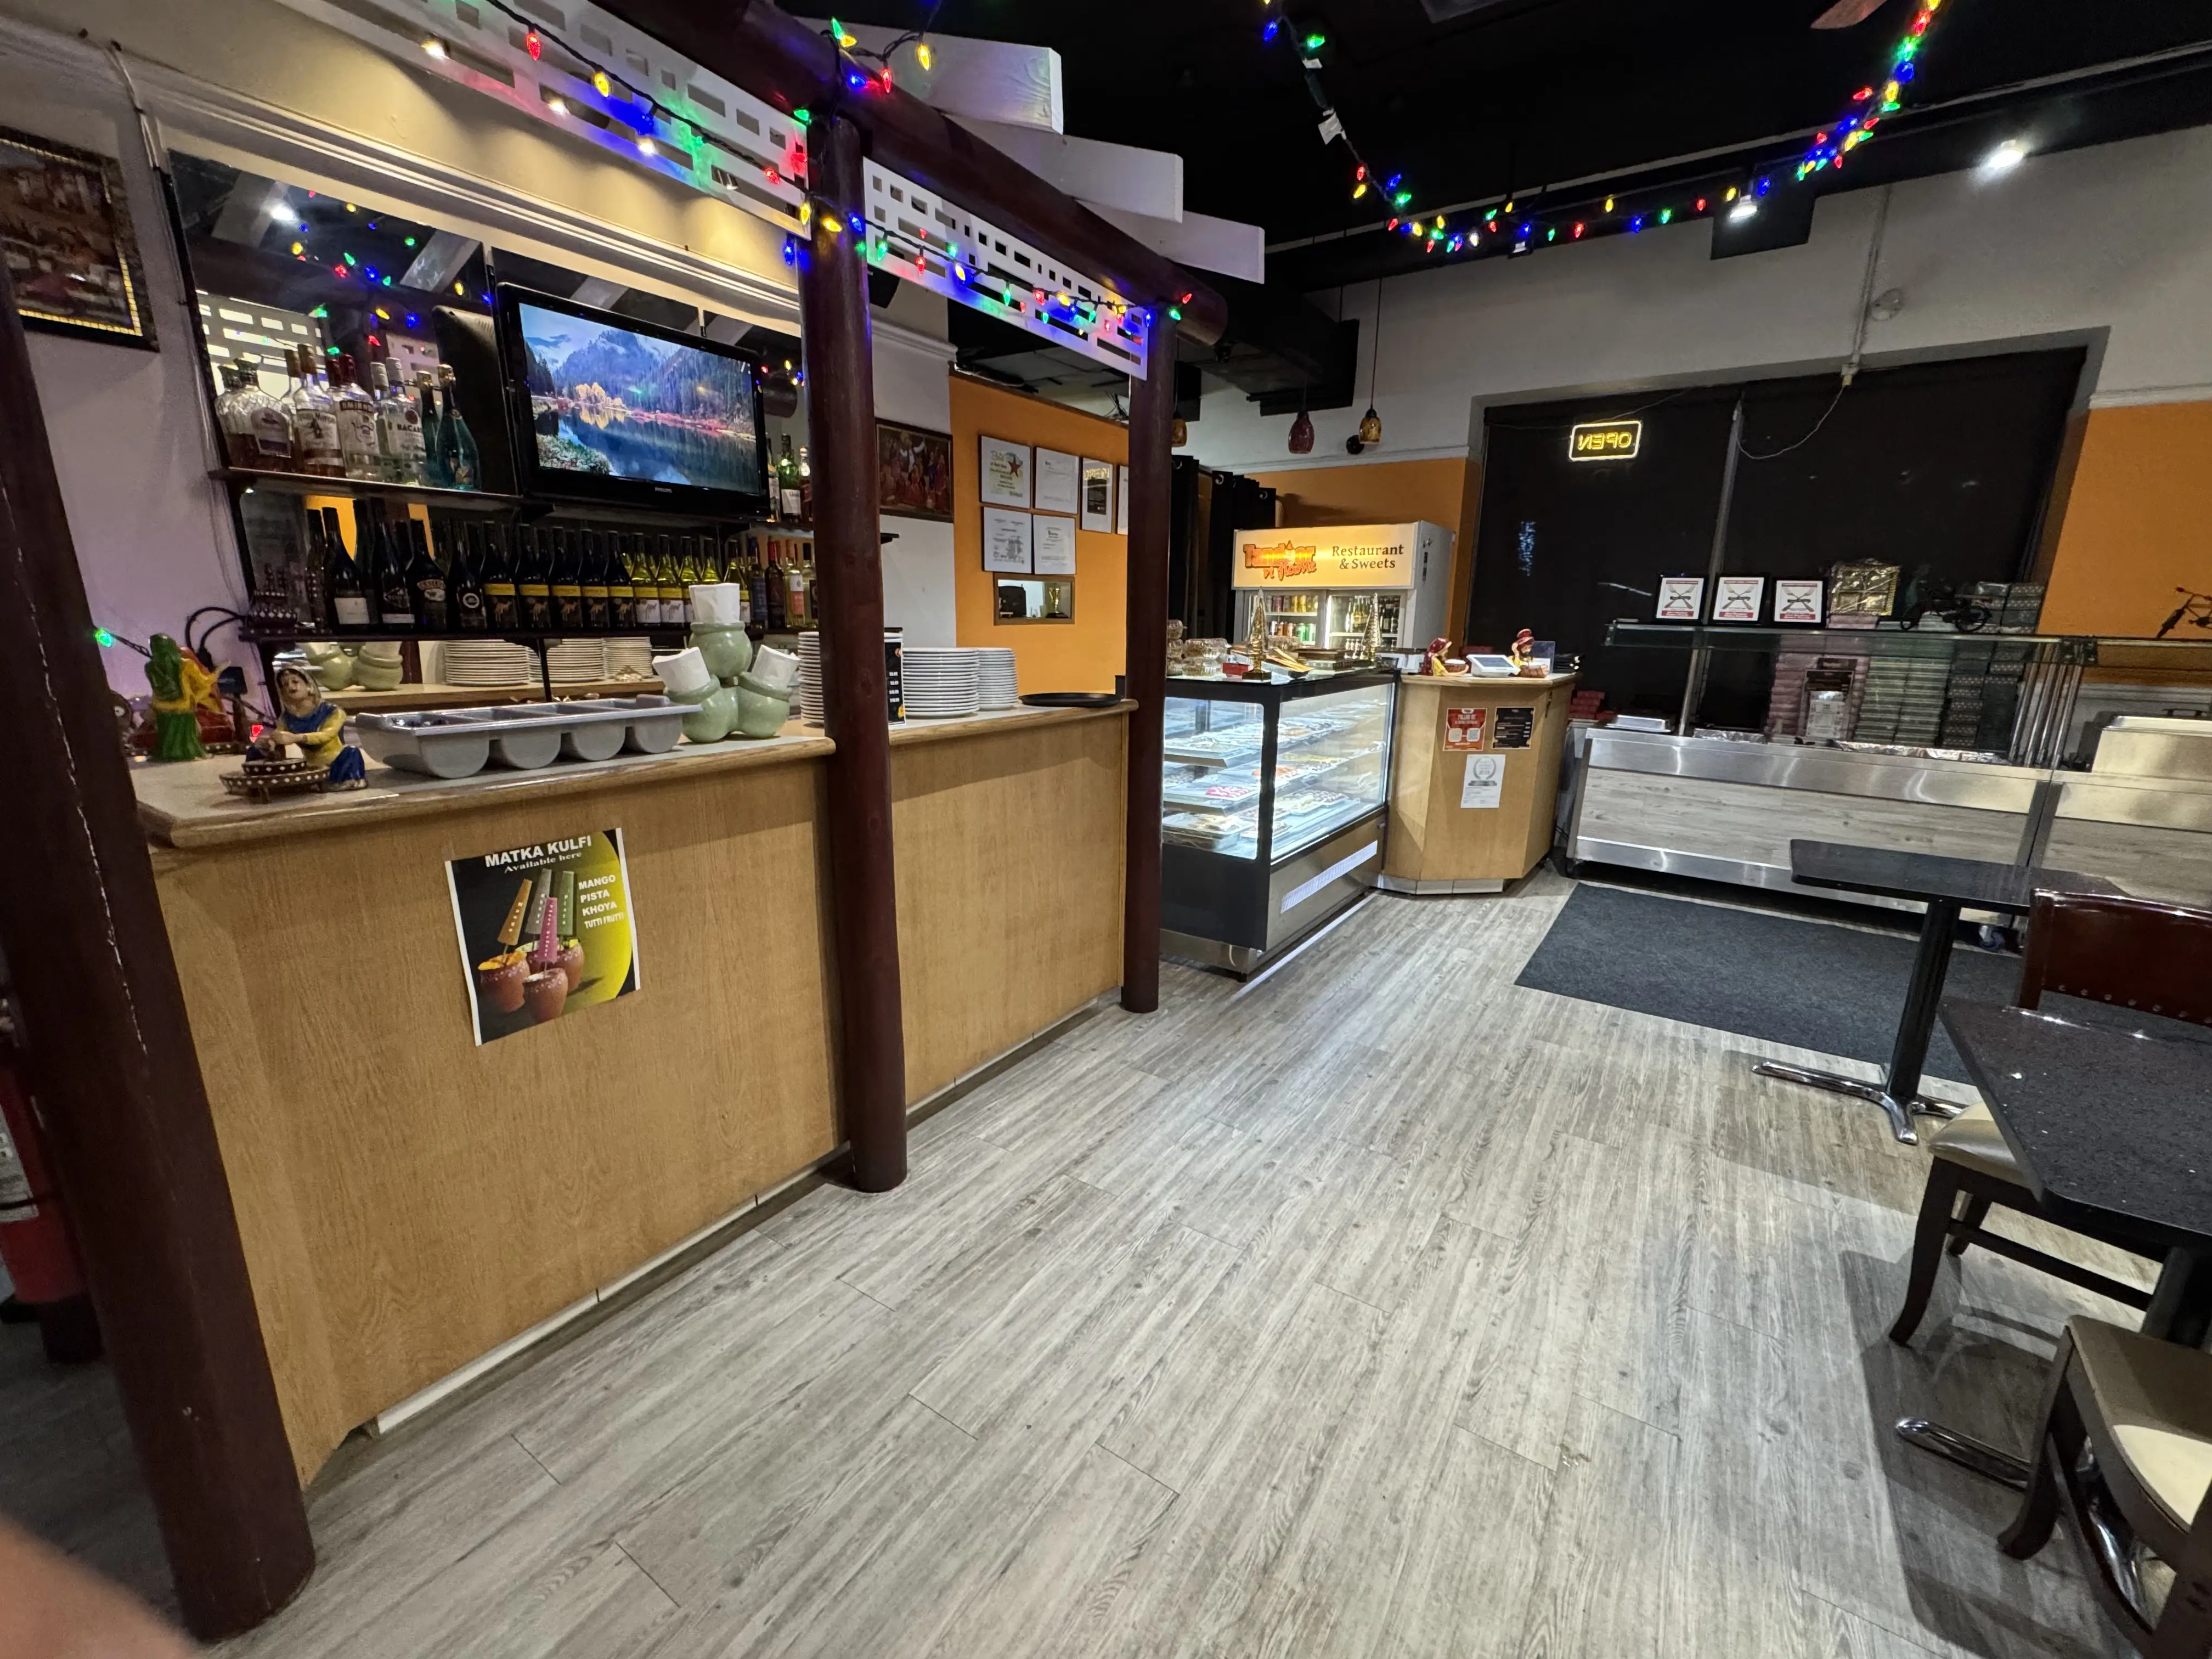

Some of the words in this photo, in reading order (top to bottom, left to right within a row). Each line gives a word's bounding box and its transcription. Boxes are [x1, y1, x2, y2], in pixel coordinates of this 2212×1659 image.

[1332, 544, 1404, 556] Restaurant
[1339, 558, 1349, 569] &
[1351, 558, 1396, 569] Sweets
[484, 845, 544, 868] MATKA
[547, 834, 592, 855] KULFI
[504, 857, 556, 874] Available
[558, 851, 582, 862] here
[578, 874, 616, 890] MANGO
[580, 889, 610, 904] PISTA
[582, 901, 618, 917] KHOYA
[584, 917, 603, 929] TUTTI
